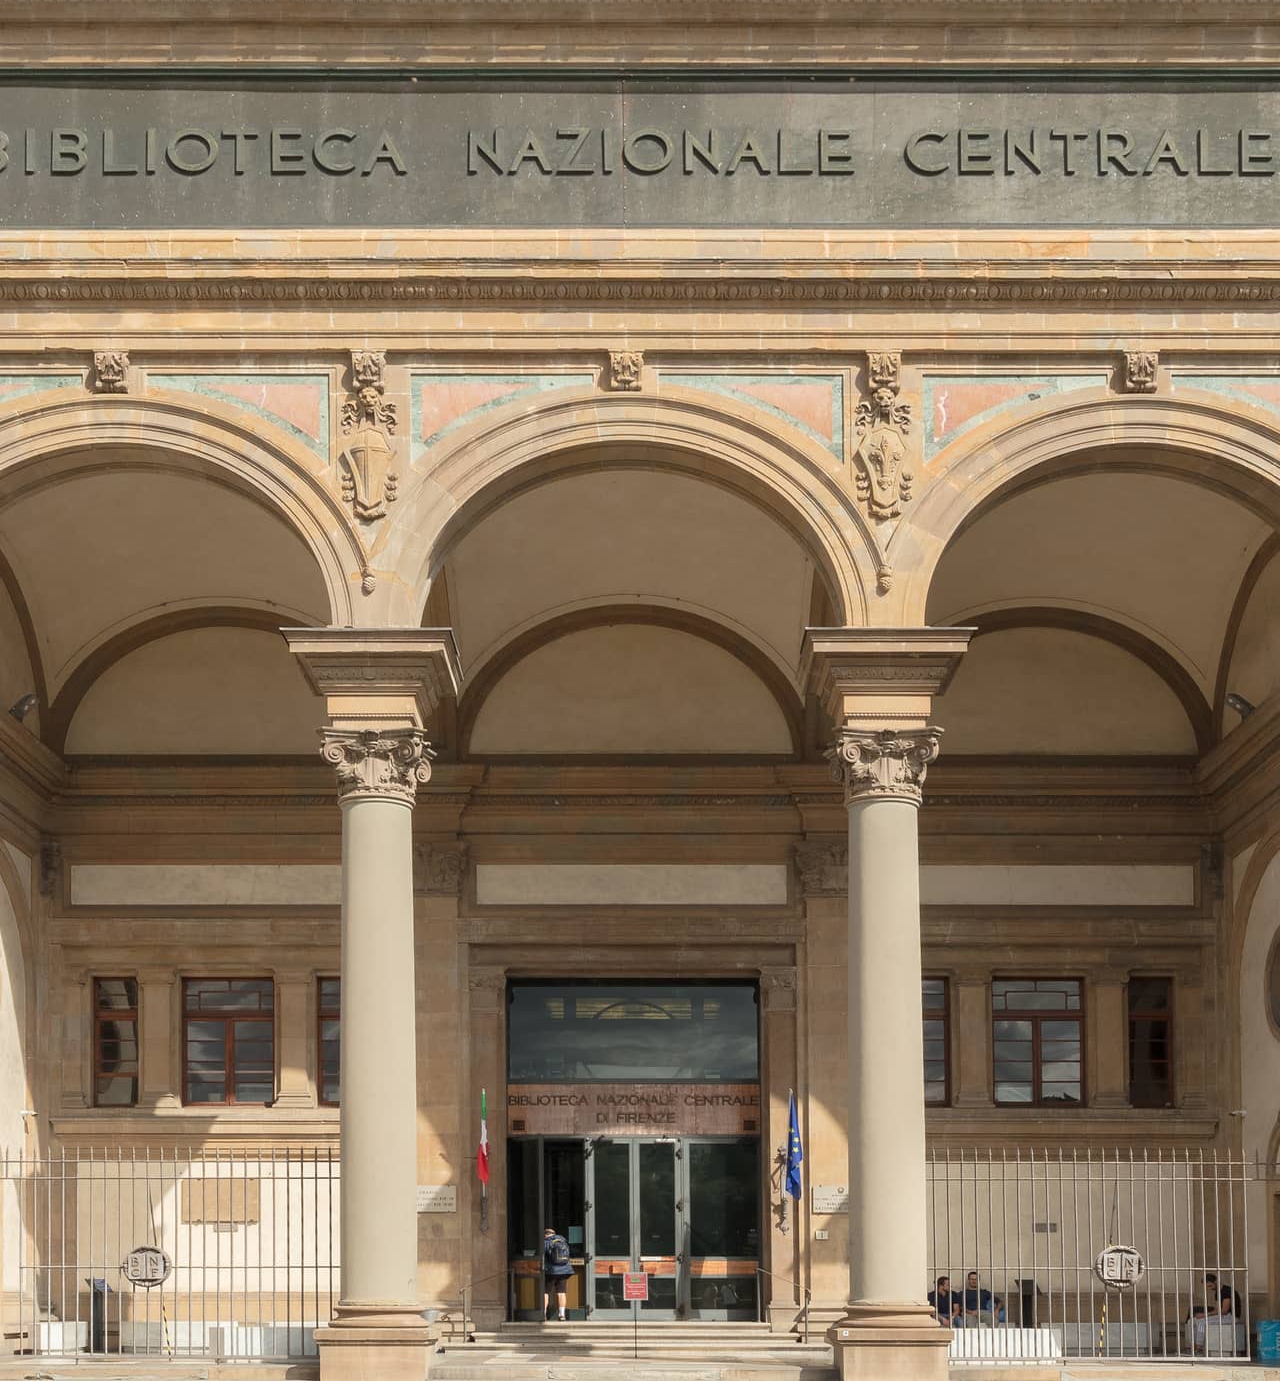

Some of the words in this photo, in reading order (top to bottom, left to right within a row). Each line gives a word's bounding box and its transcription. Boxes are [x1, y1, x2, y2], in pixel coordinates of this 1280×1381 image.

[465, 127, 854, 177] NAZIONALE
[903, 127, 1275, 177] CENTRALE
[508, 1095, 589, 1106] BIBLIOTECA
[596, 1095, 677, 1106] NAZIONALE
[684, 1095, 759, 1106] CENTRALE
[596, 1113, 610, 1123] DI
[616, 1113, 676, 1123] FIRENZE
